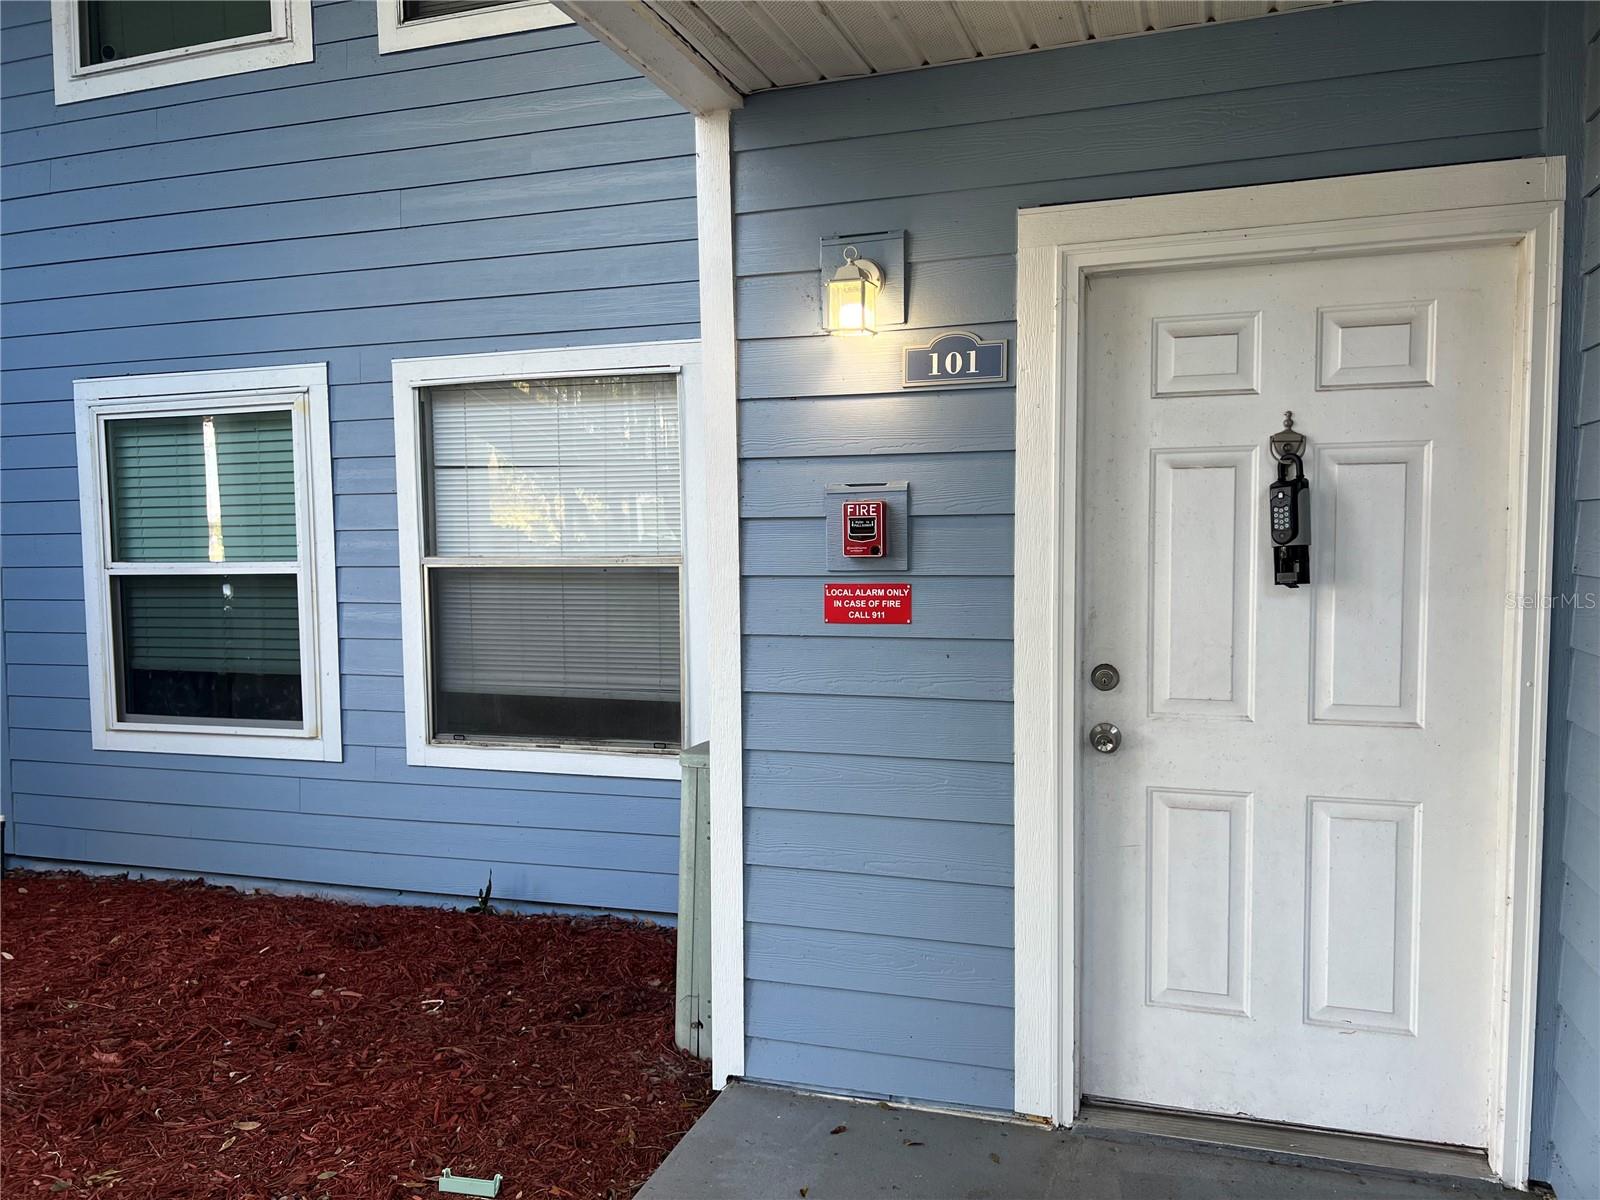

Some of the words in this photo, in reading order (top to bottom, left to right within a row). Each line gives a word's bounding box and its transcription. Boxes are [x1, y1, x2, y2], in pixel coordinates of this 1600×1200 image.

[928, 350, 979, 376] 101
[847, 504, 877, 516] FIRE
[826, 588, 854, 597] LOCAL
[855, 588, 884, 597] ALARM
[887, 588, 909, 597] ONLY
[833, 599, 842, 608] IN
[843, 599, 866, 608] CASE
[868, 599, 880, 608] OF
[882, 599, 901, 608] FIRE
[848, 611, 870, 619] CALL
[871, 611, 885, 619] 911
